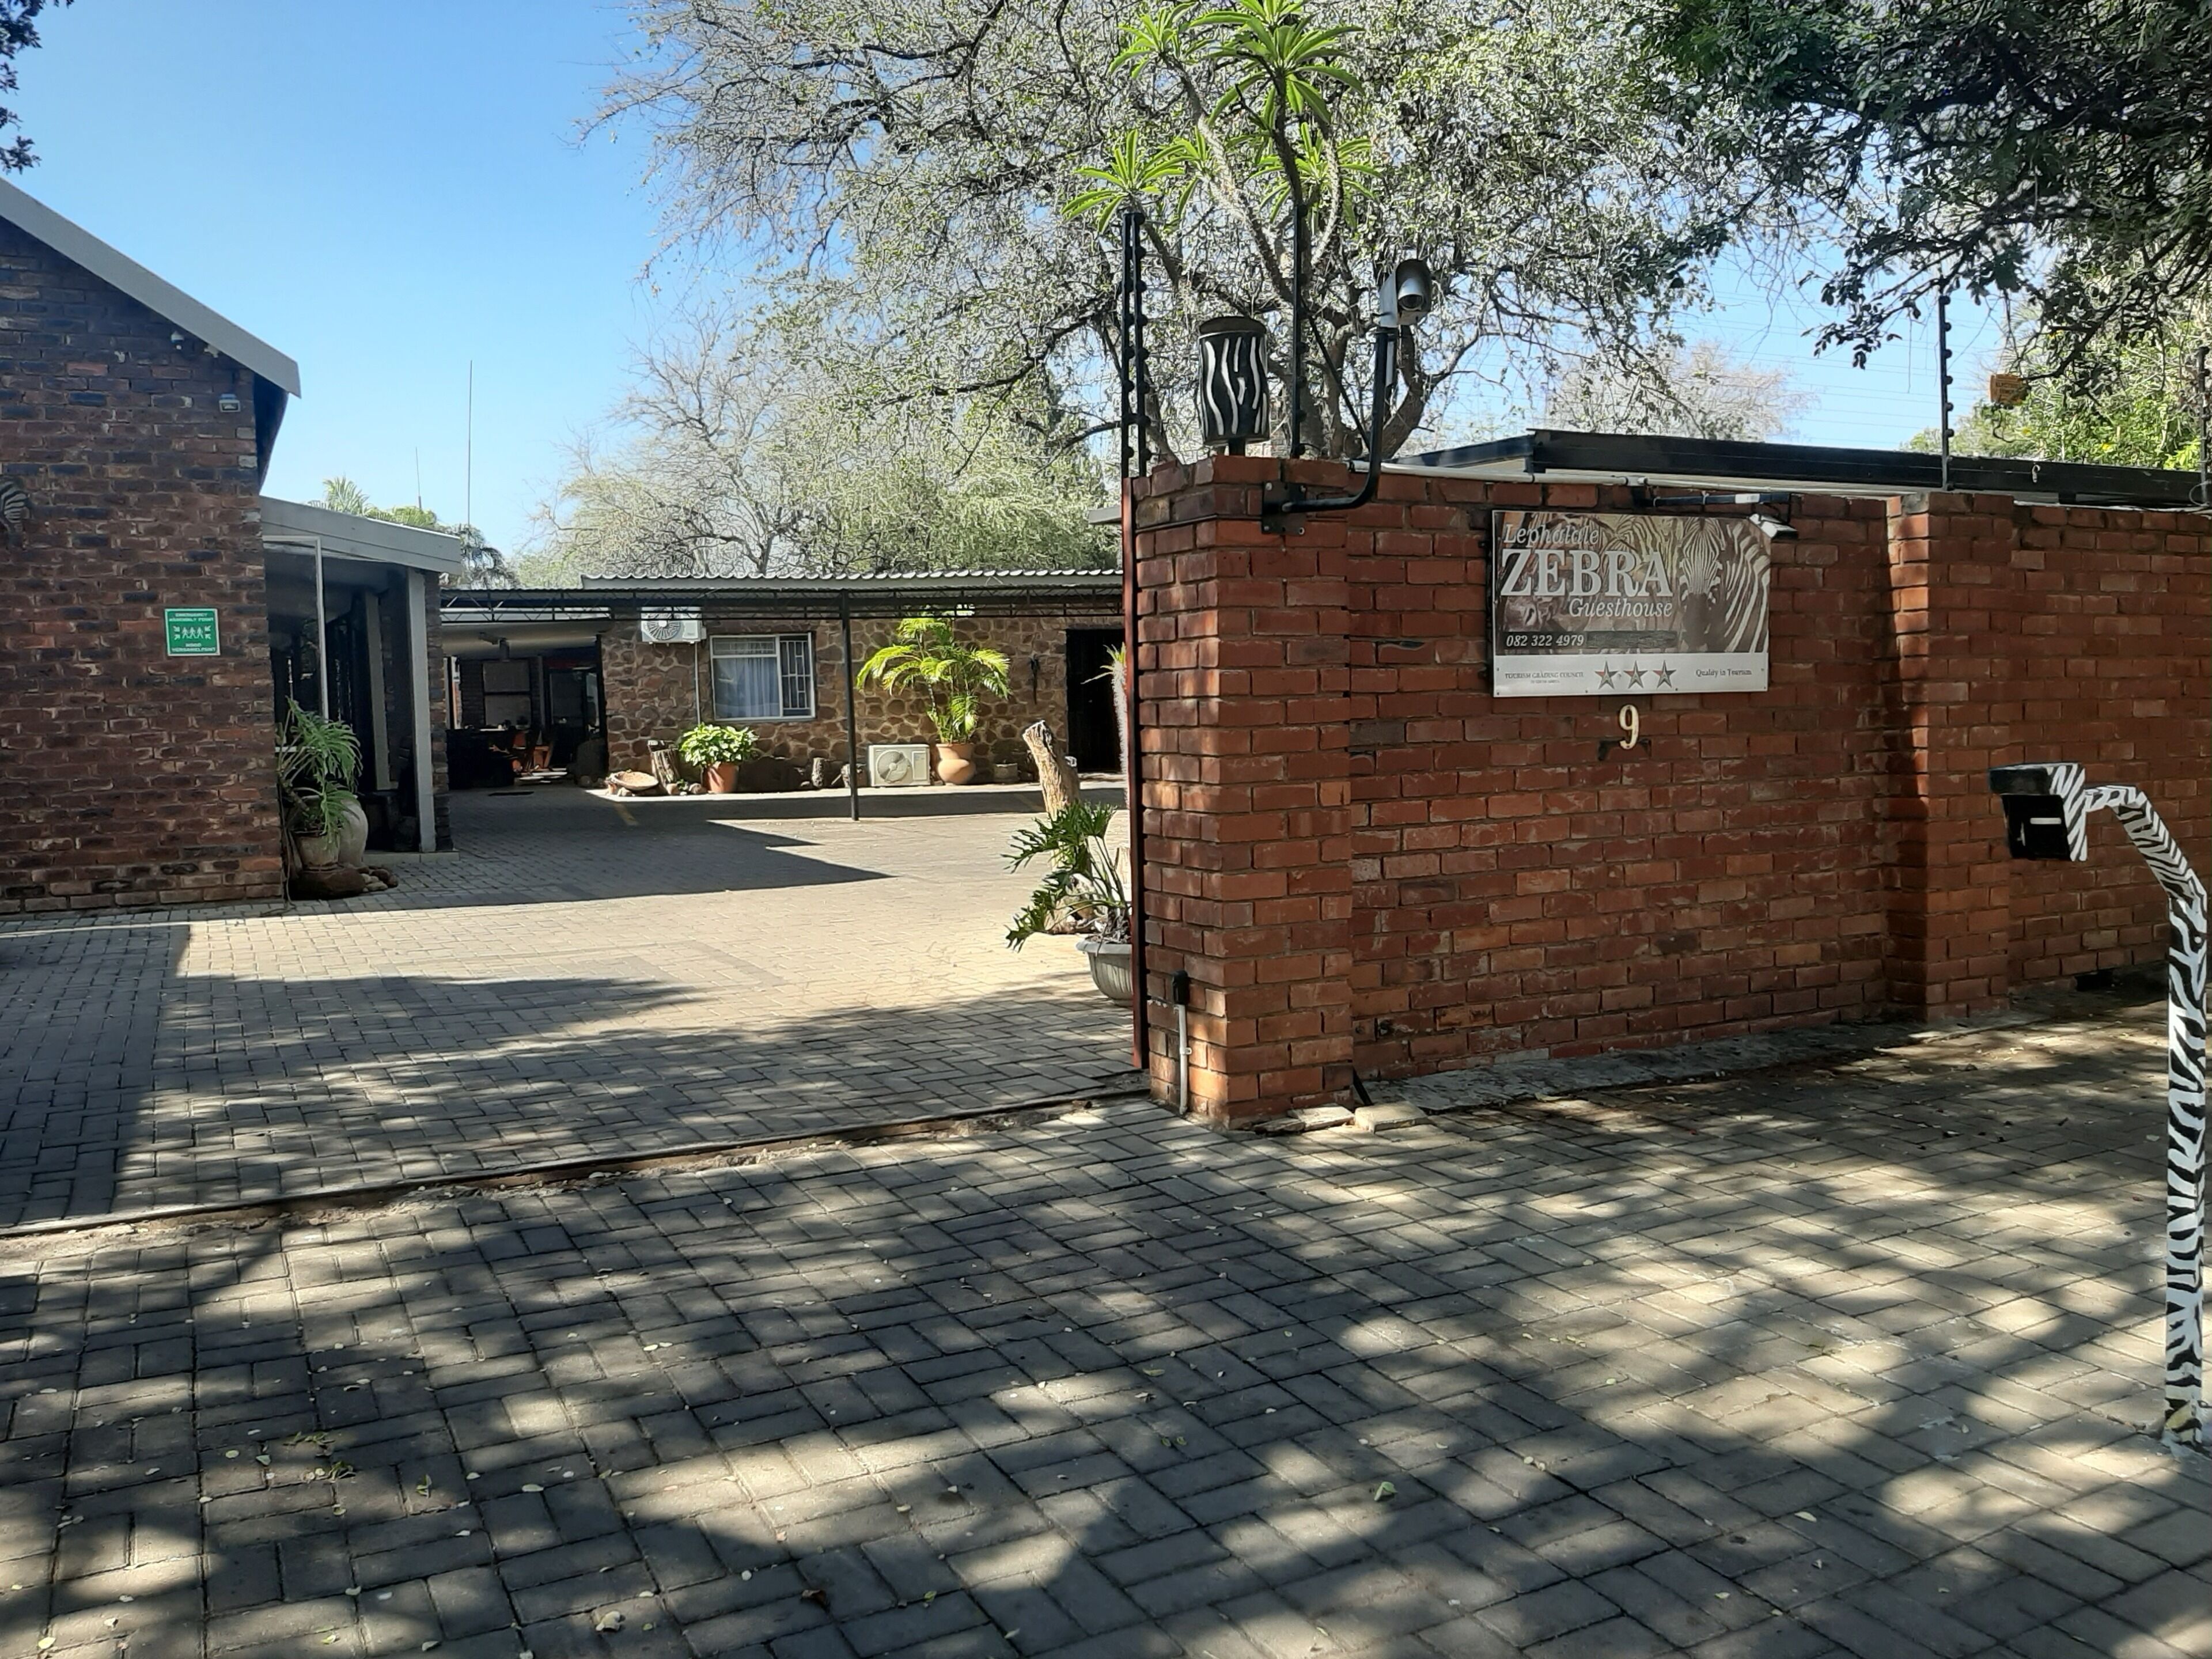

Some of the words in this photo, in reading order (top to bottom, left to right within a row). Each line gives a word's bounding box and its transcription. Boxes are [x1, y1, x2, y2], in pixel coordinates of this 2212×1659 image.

[1503, 523, 1600, 547] Lephalale
[1500, 548, 1673, 597] ZEBRA
[1569, 598, 1673, 618] Guesthouse
[1506, 635, 1528, 647] 082
[1531, 634, 1552, 647] 322
[1556, 634, 1584, 646] 4979
[1695, 669, 1718, 677] Quality
[1727, 668, 1752, 676] Tourism
[1619, 704, 1639, 749] 9
